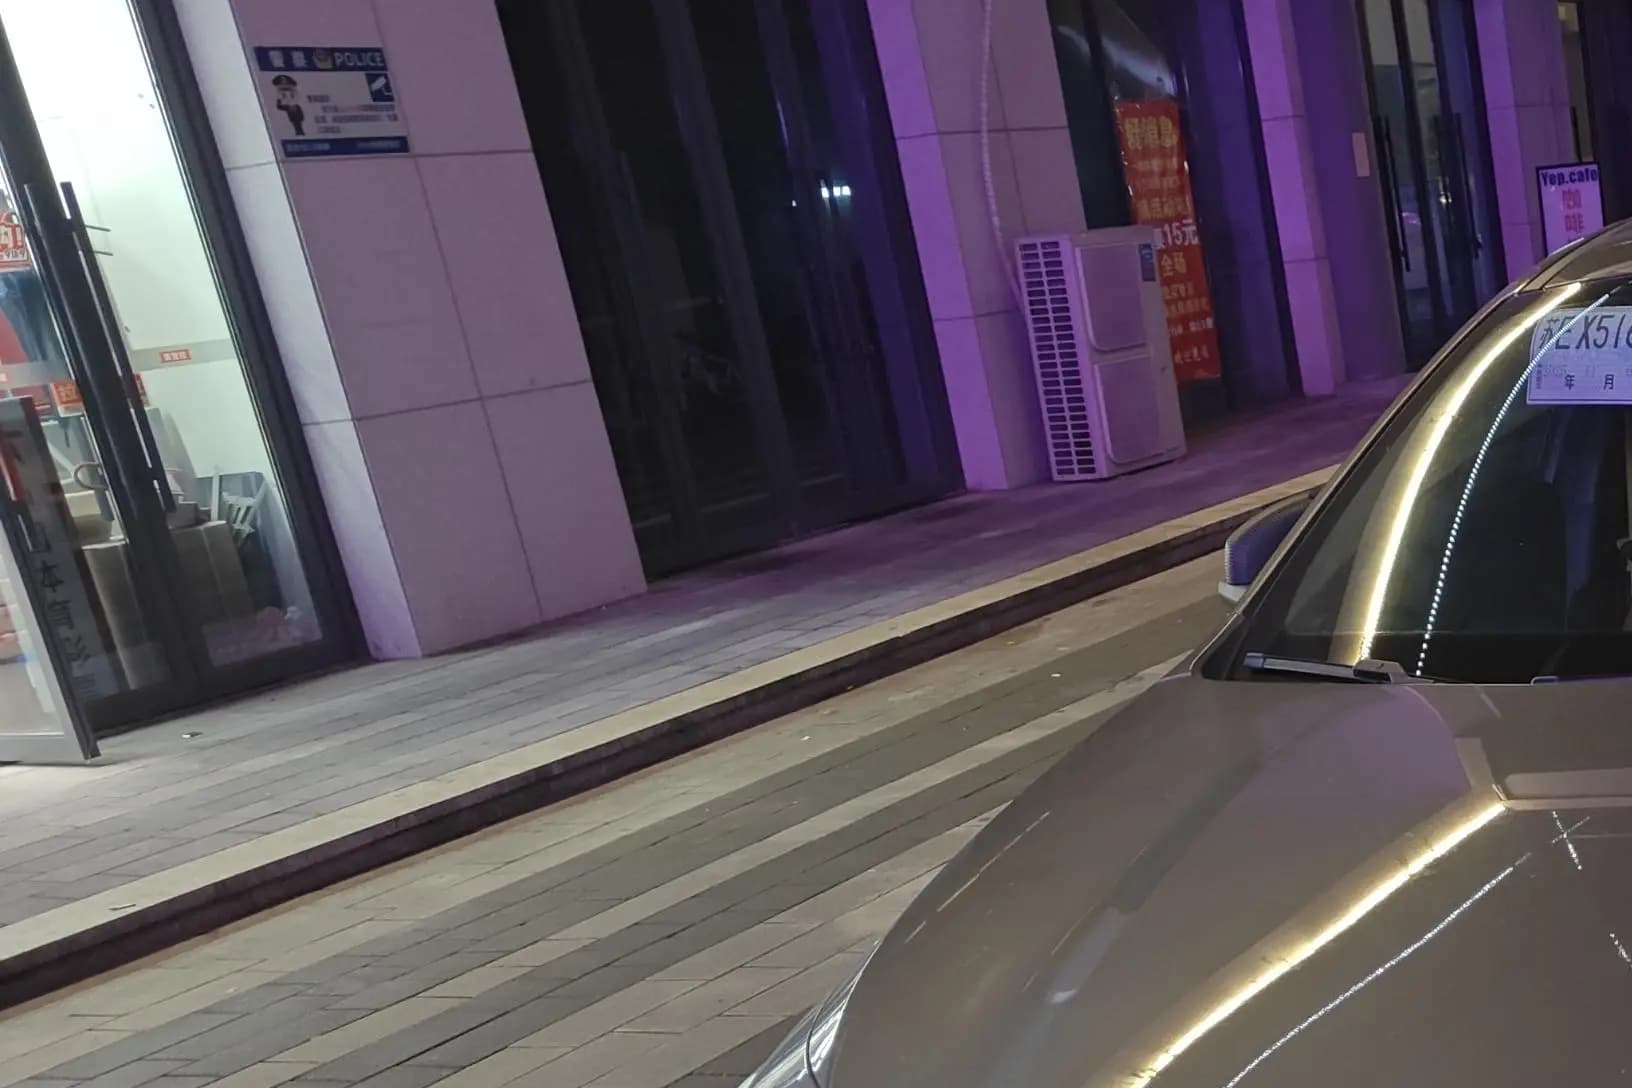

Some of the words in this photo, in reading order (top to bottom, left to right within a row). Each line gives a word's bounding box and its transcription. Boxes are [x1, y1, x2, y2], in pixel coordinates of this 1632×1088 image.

[333, 51, 386, 67] POLICE
[1565, 374, 1576, 390] 年
[1603, 373, 1615, 390] 月
